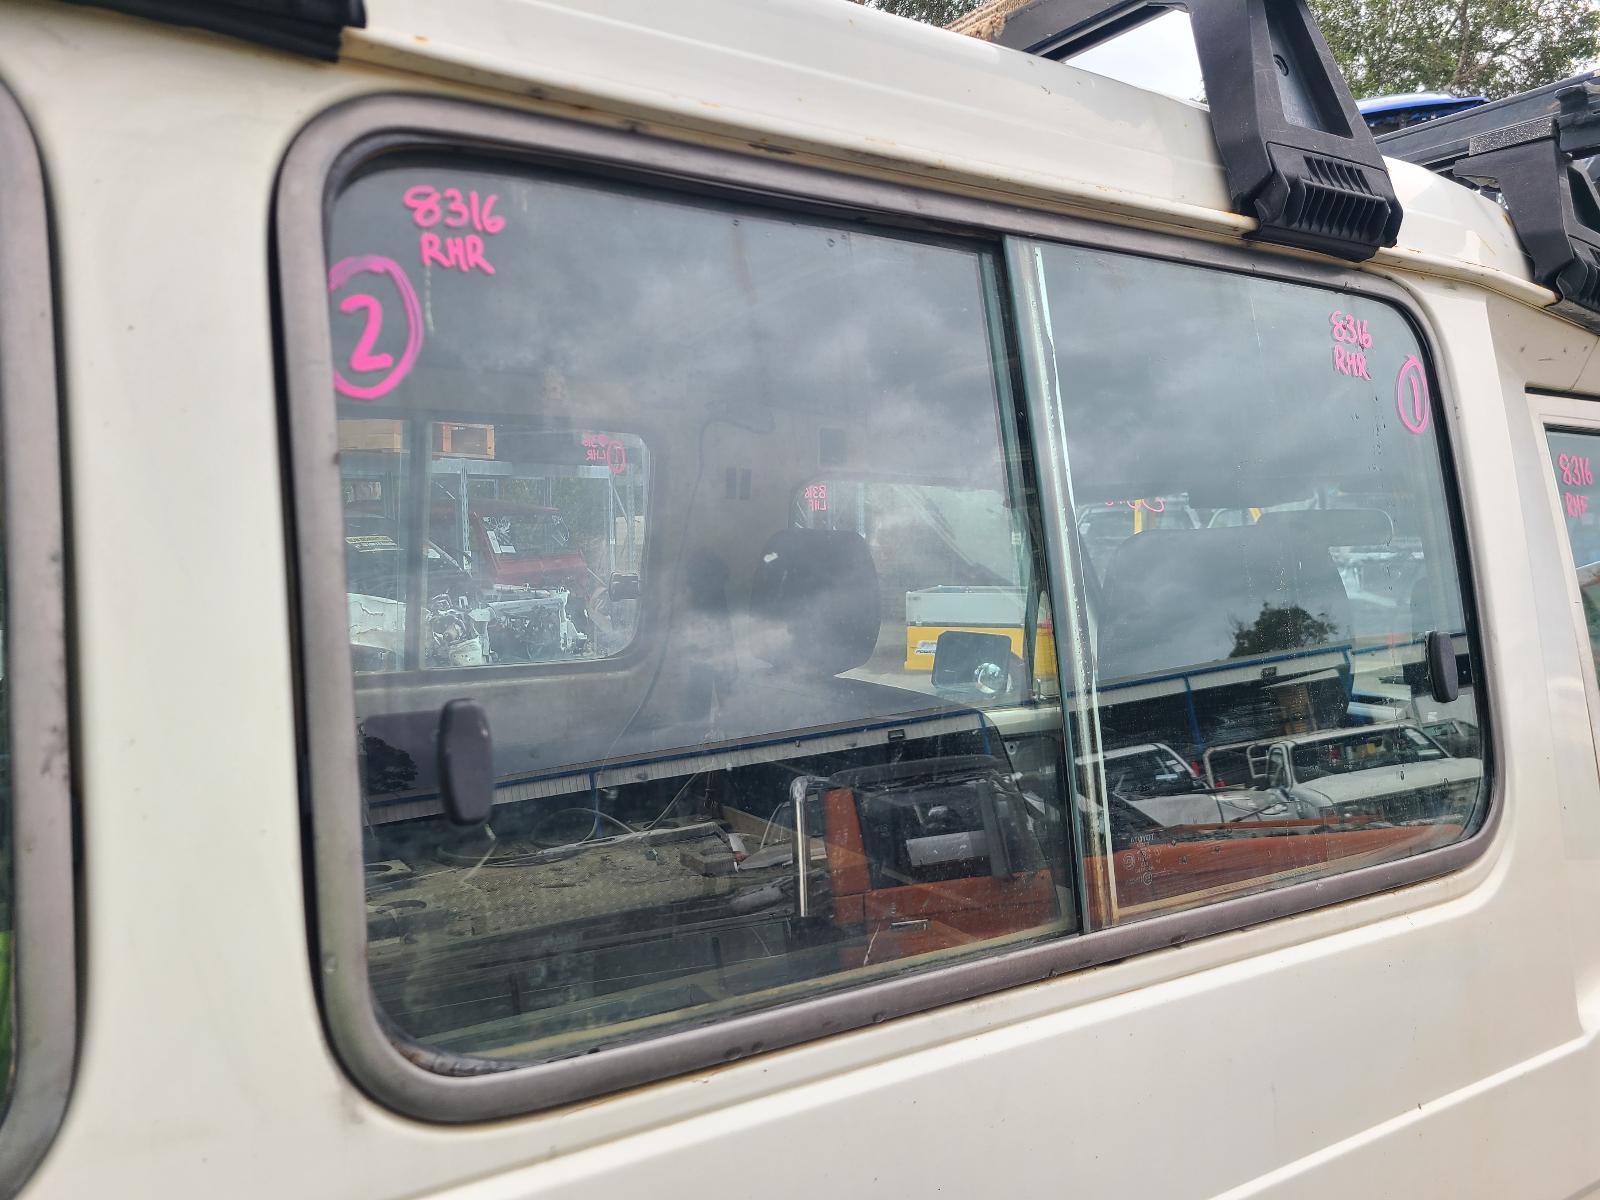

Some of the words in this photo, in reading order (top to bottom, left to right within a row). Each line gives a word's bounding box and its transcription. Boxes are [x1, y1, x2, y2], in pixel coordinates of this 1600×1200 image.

[403, 185, 506, 234] 8316
[419, 232, 496, 275] RHR
[340, 294, 394, 372] 2
[1330, 310, 1373, 349] 8316
[1333, 345, 1372, 382] RHR
[1558, 453, 1594, 486] 8316
